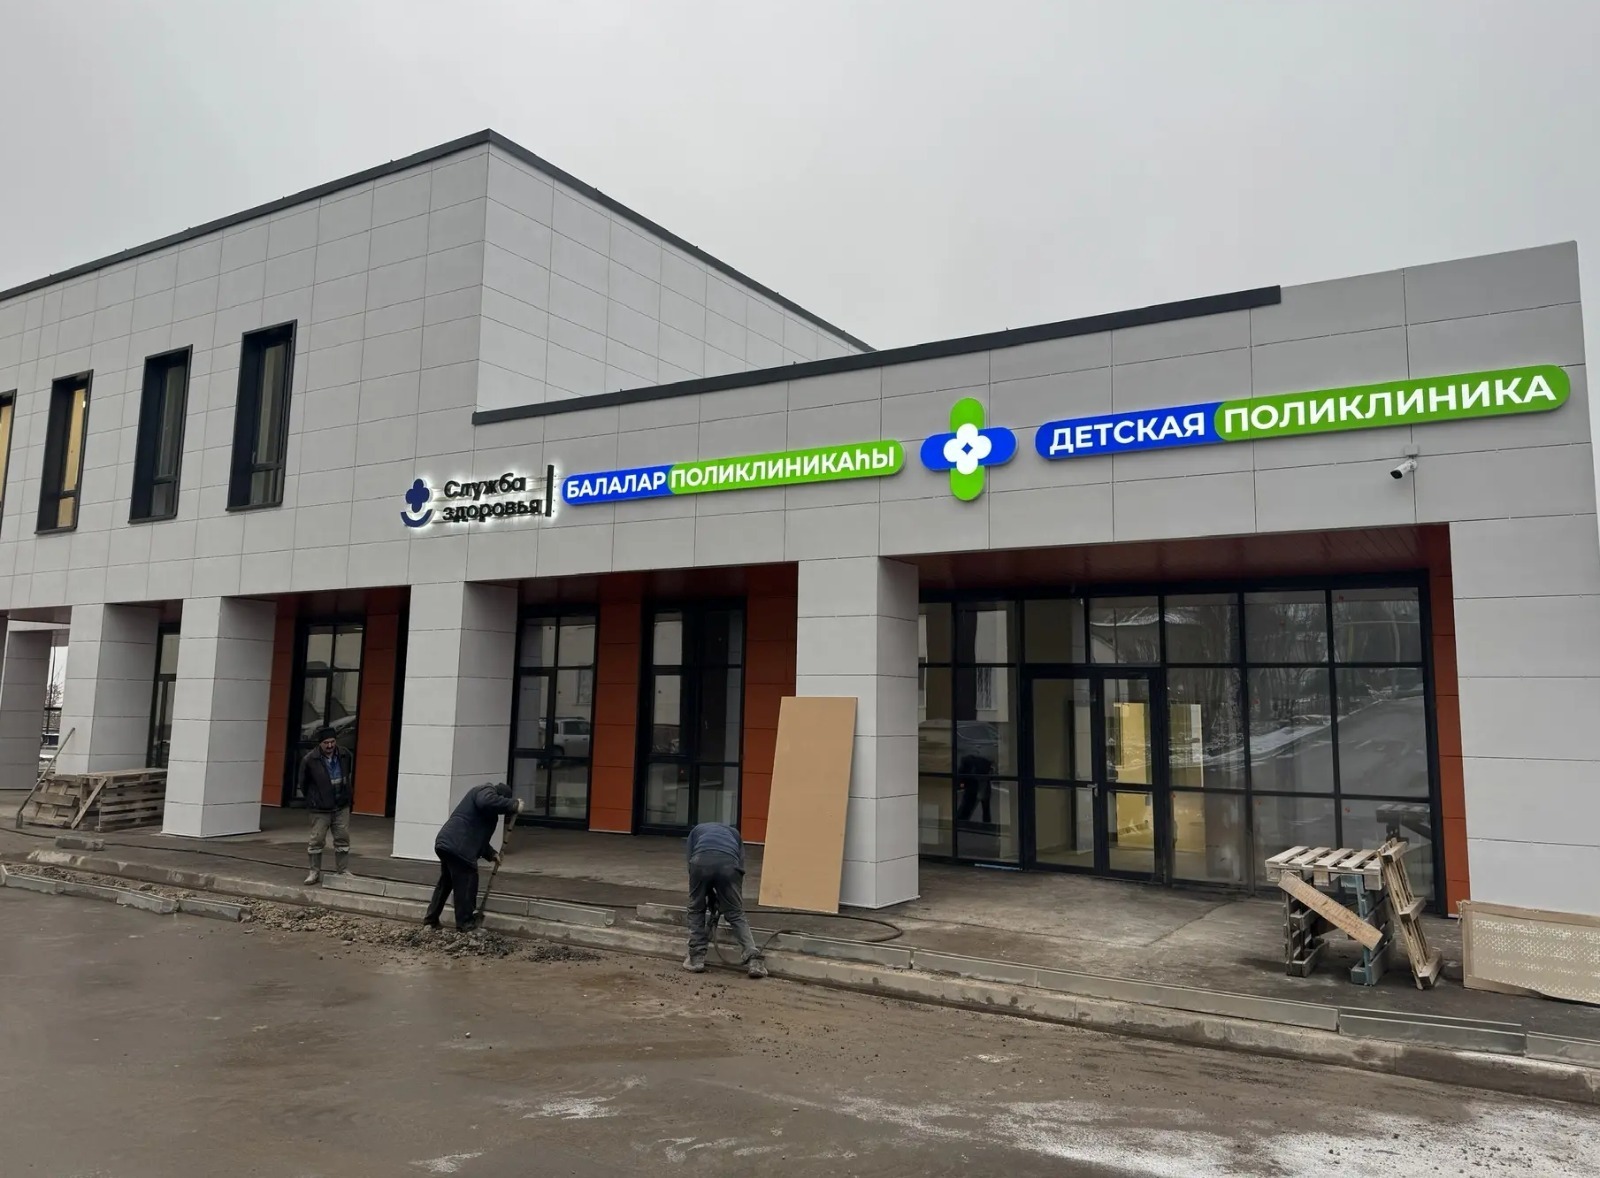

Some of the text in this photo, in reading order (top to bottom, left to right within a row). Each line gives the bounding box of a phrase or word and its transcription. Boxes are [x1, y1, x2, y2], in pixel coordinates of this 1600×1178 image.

[1049, 374, 1557, 455] ДЕТСКАЯ ПОЛИКЛИНИКА
[444, 473, 527, 501] Служба
[566, 472, 667, 499] БАЛАЛАР
[442, 498, 542, 523] здоровья
